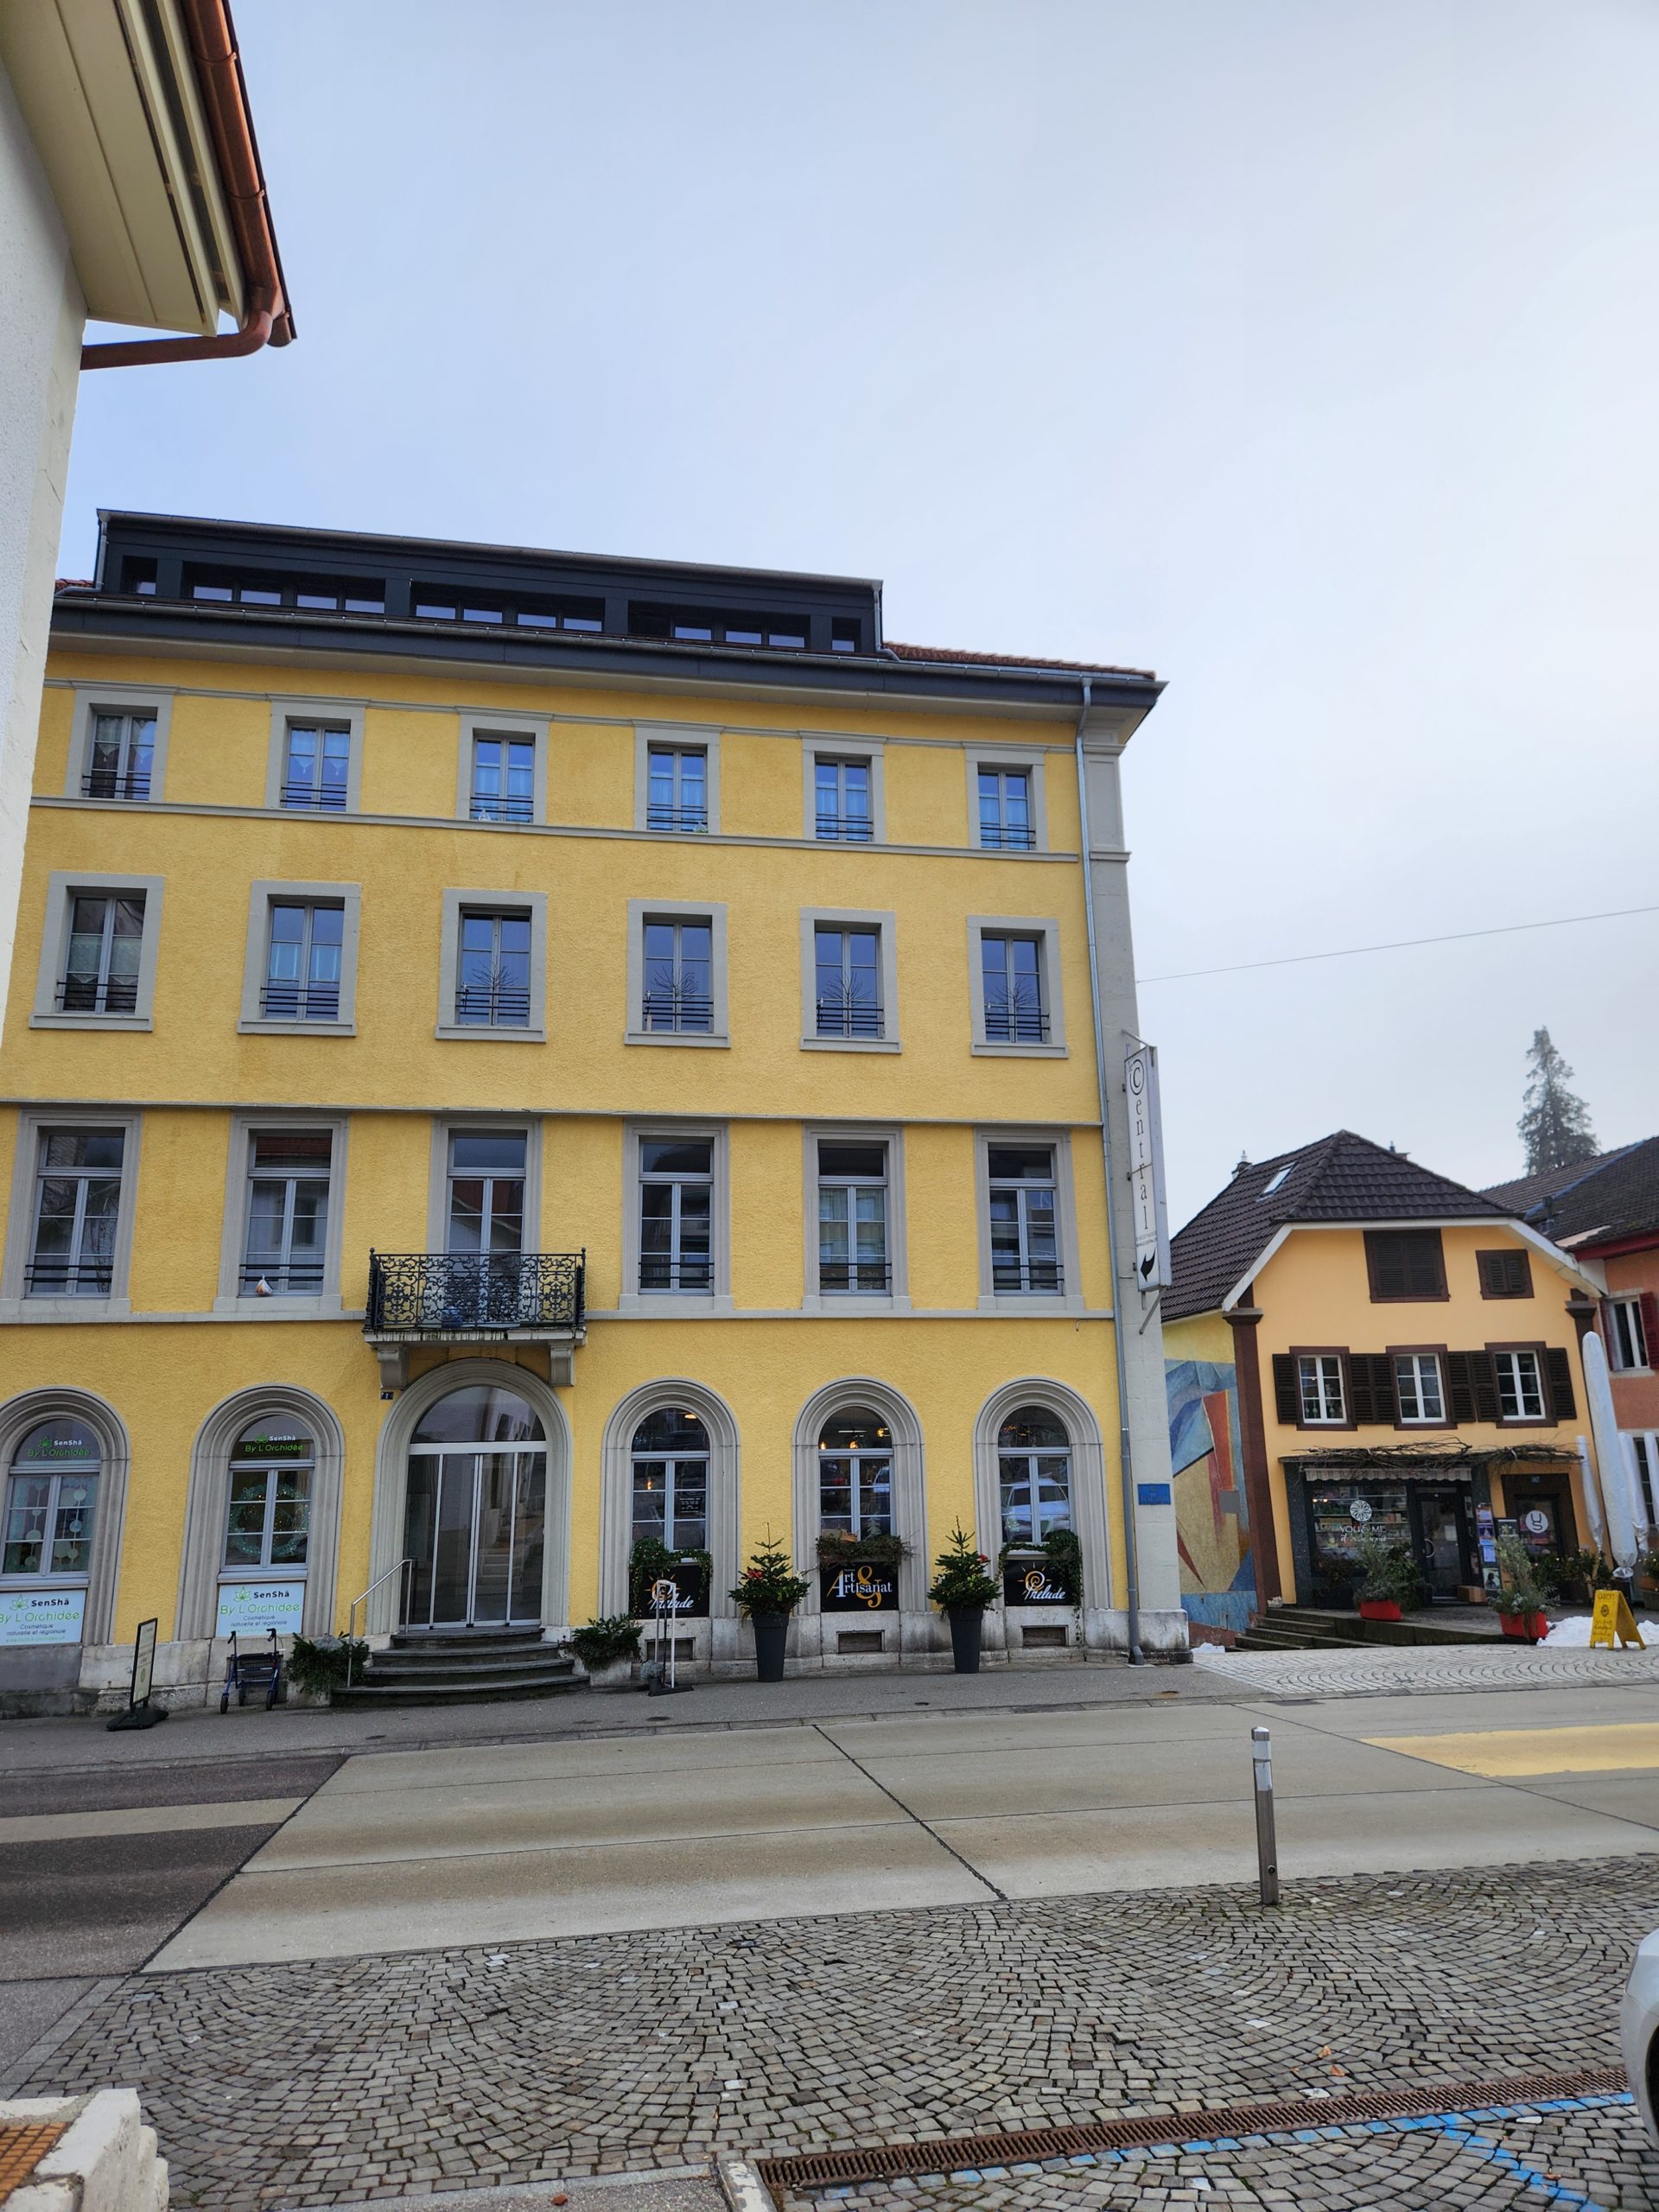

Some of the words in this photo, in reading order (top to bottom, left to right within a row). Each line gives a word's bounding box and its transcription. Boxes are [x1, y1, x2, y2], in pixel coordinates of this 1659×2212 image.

[1129, 1058, 1147, 1230] Central
[28, 1448, 39, 1458] By
[827, 1580, 893, 1597] Artisanat
[856, 1565, 881, 1608] &
[220, 1605, 235, 1616] By
[0, 1612, 11, 1624] By
